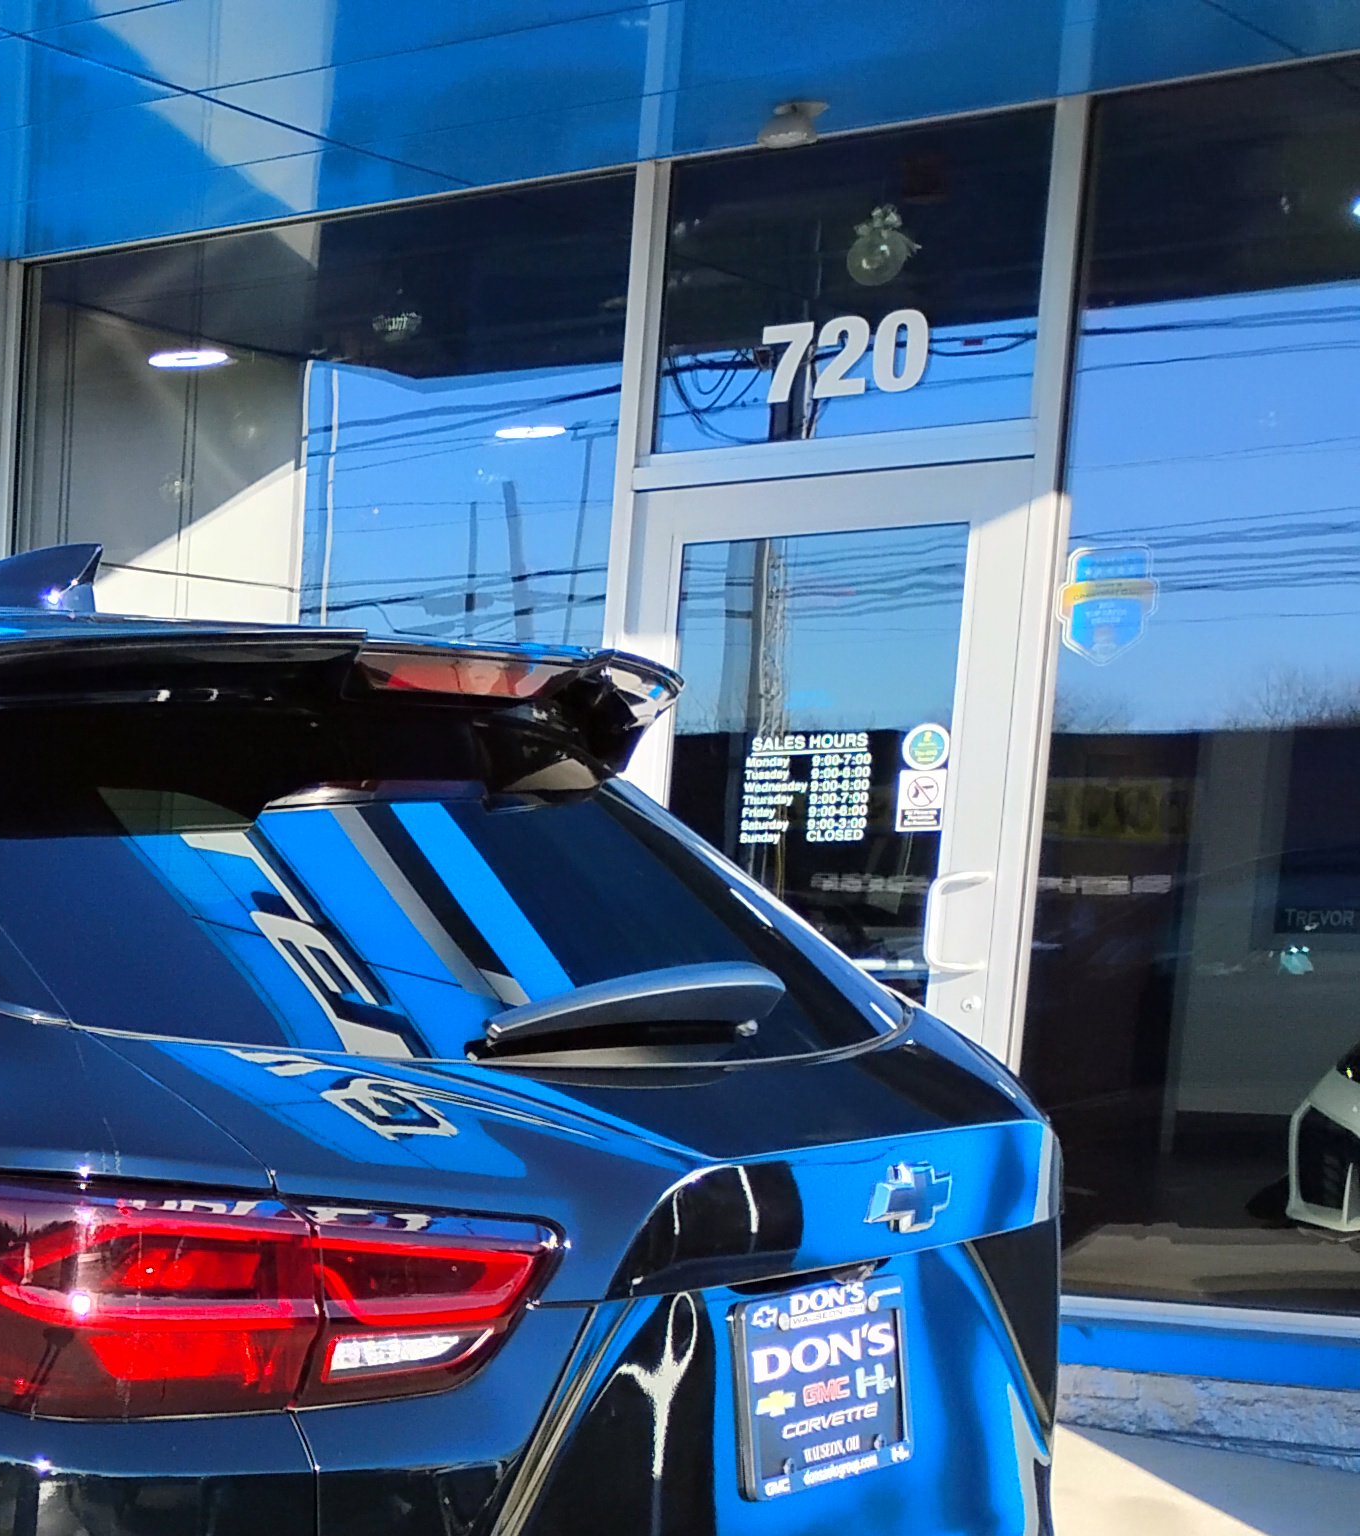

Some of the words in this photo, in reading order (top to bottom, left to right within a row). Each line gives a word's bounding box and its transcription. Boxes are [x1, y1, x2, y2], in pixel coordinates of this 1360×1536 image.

[762, 309, 929, 404] 720
[752, 735, 806, 751] SALES
[809, 733, 869, 749] HOURS
[745, 756, 791, 768] Monday
[744, 769, 790, 781] Tuesday
[743, 781, 808, 793] Wednesday
[742, 794, 794, 806] Thursday
[742, 807, 776, 819] Friday
[741, 819, 789, 832] Saturday
[739, 832, 781, 844] Sunday
[806, 829, 864, 842] CLOSED
[1284, 908, 1355, 926] TREVOR
[789, 1282, 865, 1316] DON'S
[751, 1322, 896, 1384] DON'S
[803, 1375, 851, 1407] GMC
[781, 1402, 879, 1440] CORVETTE
